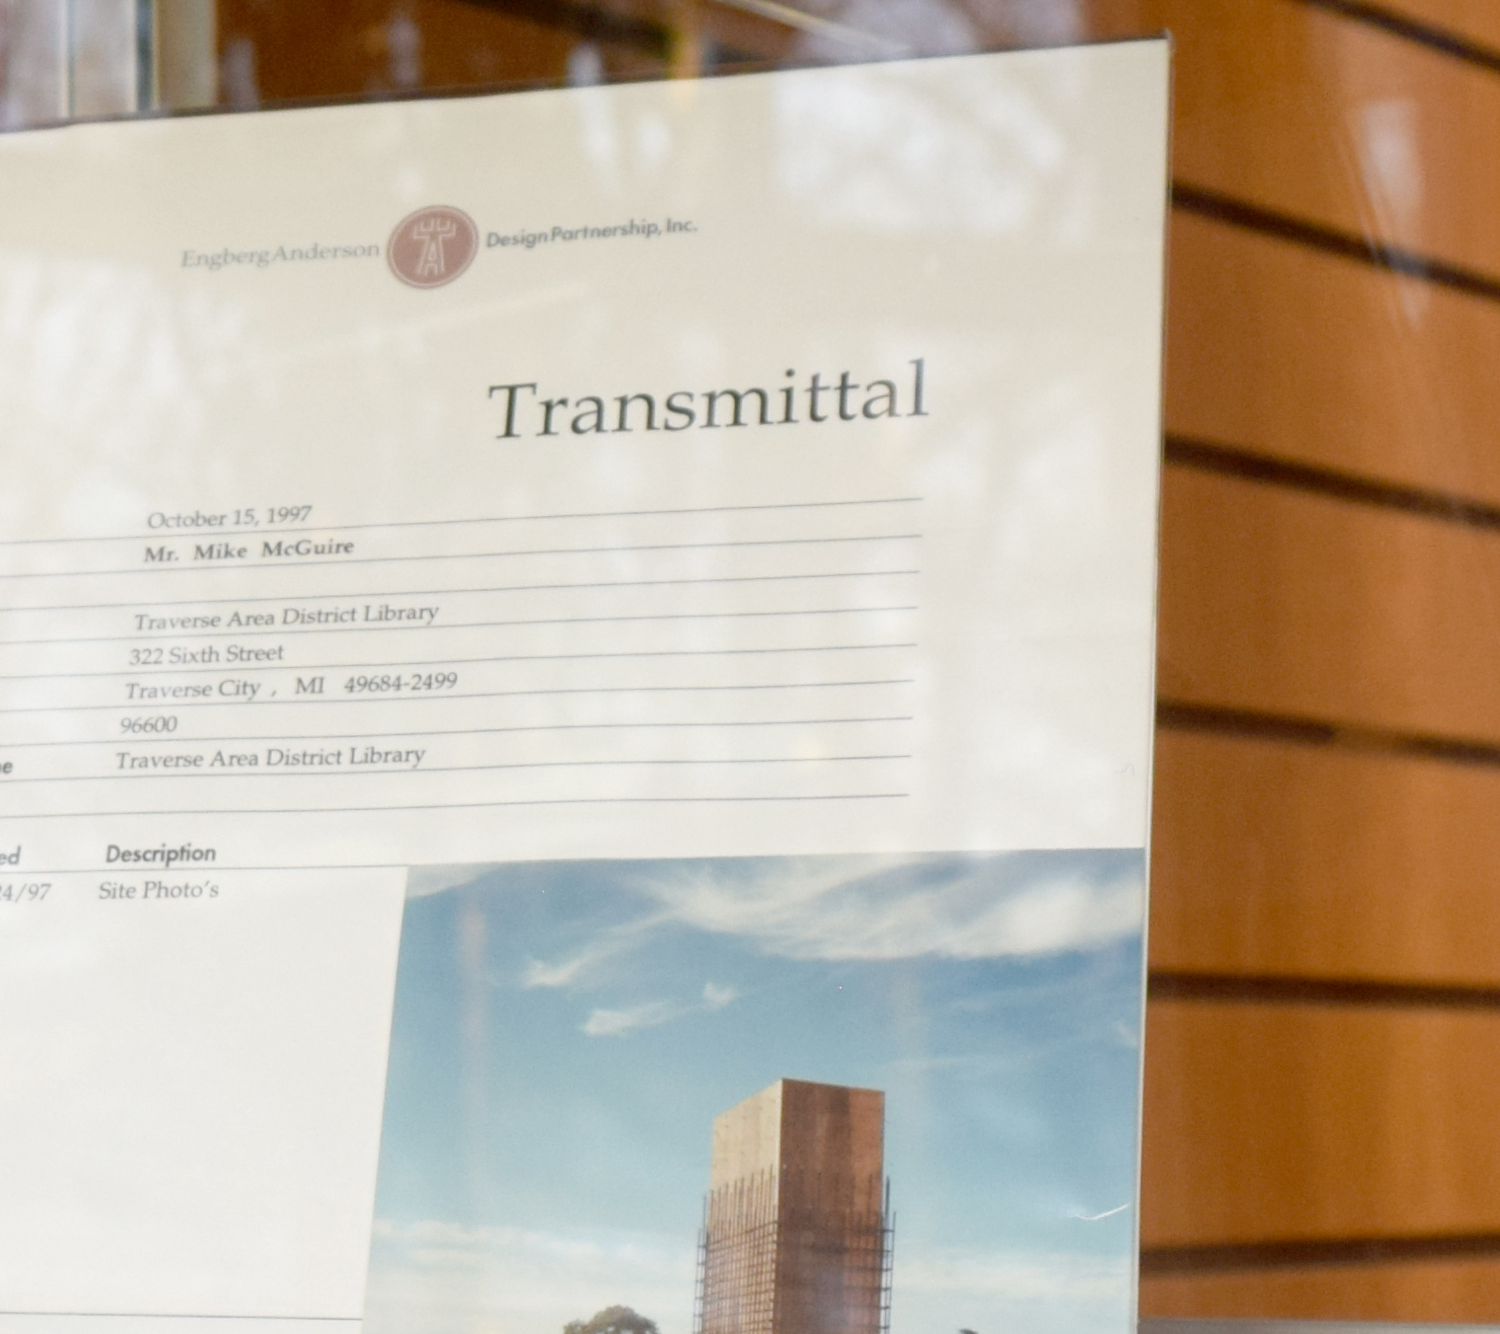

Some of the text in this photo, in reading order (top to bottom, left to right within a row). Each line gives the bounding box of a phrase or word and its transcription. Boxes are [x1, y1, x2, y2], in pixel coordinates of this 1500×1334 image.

[666, 217, 699, 235] Inc.
[488, 357, 930, 439] Transmittal
[147, 505, 313, 531] October 15, 1997
[143, 537, 355, 564] Mr. Mike McGuire
[134, 603, 440, 631] Traverse Area District Library
[129, 643, 285, 666] 322 Sixth Street
[125, 680, 213, 700] Traverse
[217, 678, 262, 703] City
[293, 675, 326, 695] MI
[343, 671, 459, 694] 49684-2499
[120, 714, 179, 734] 96600
[115, 743, 426, 770] Traverse Area District Library
[105, 842, 217, 868] Description
[97, 881, 137, 901] Site
[142, 879, 220, 900] Photo's
